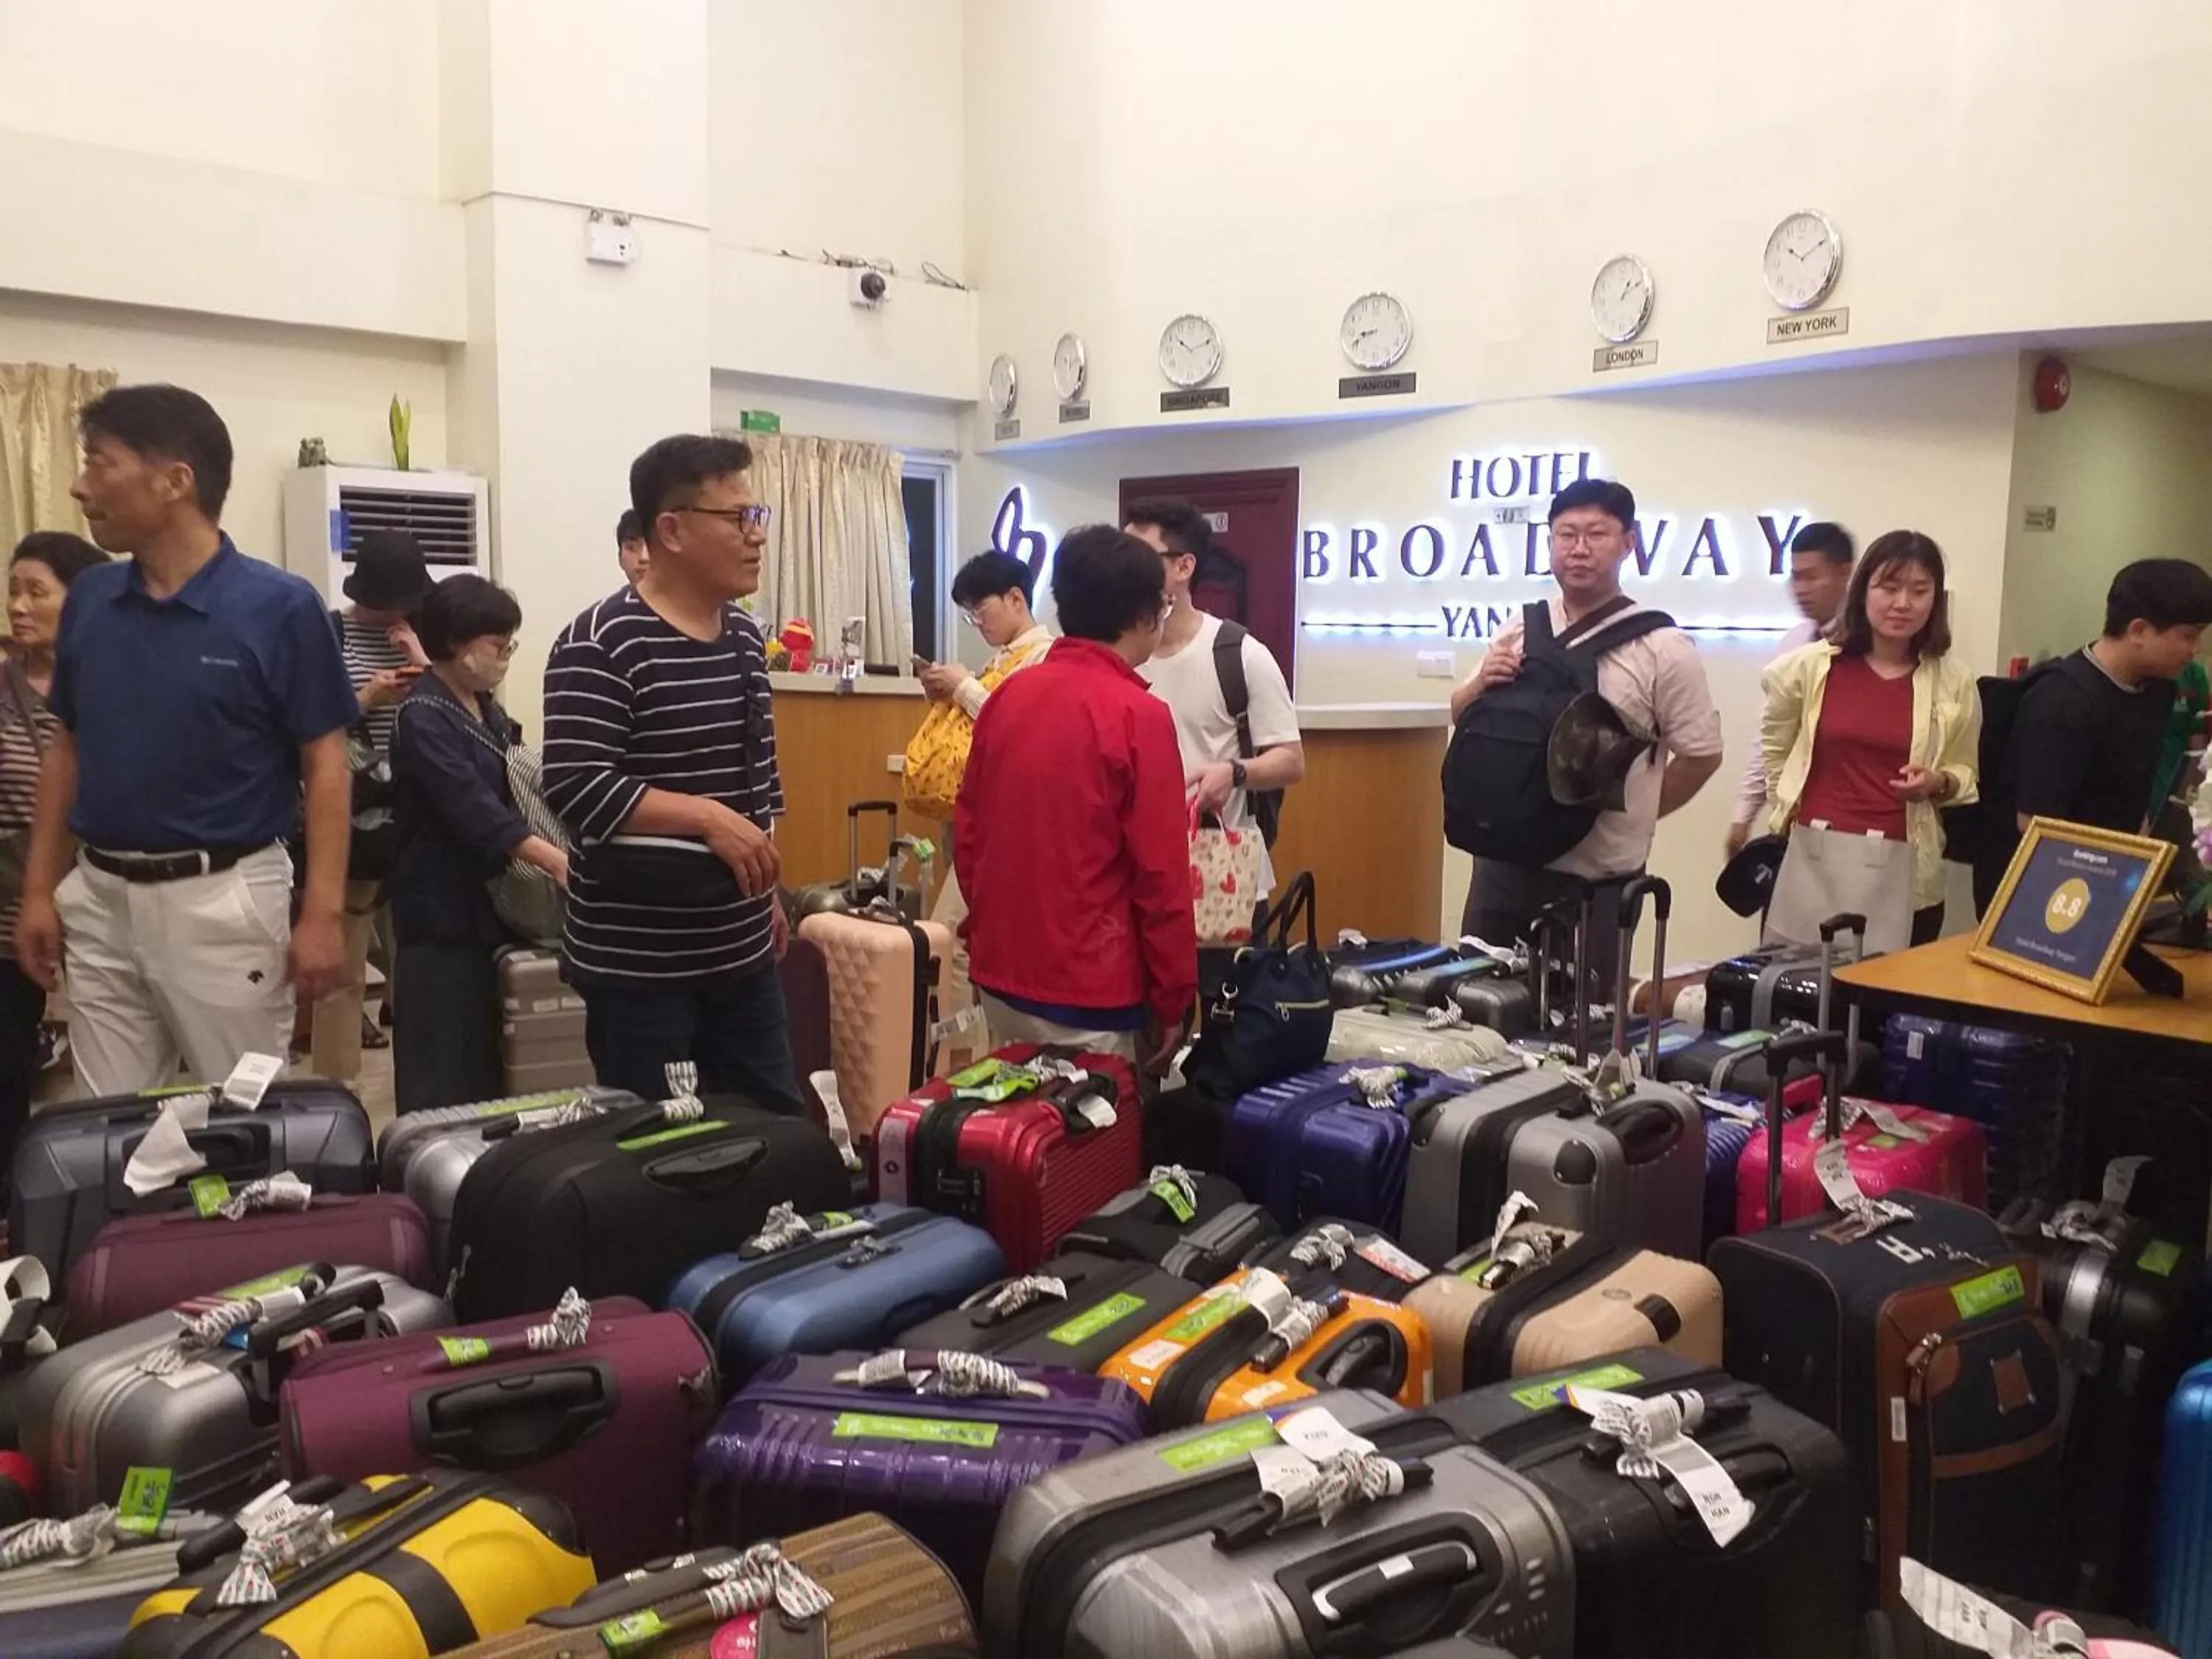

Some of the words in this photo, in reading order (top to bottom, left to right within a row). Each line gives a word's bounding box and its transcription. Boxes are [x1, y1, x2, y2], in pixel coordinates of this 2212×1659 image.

[1777, 321, 1803, 335] NEW
[1806, 316, 1837, 331] YORK
[1606, 348, 1644, 365] LONDON
[1357, 377, 1400, 392] YANGON
[2052, 893, 2082, 918] 8.8
